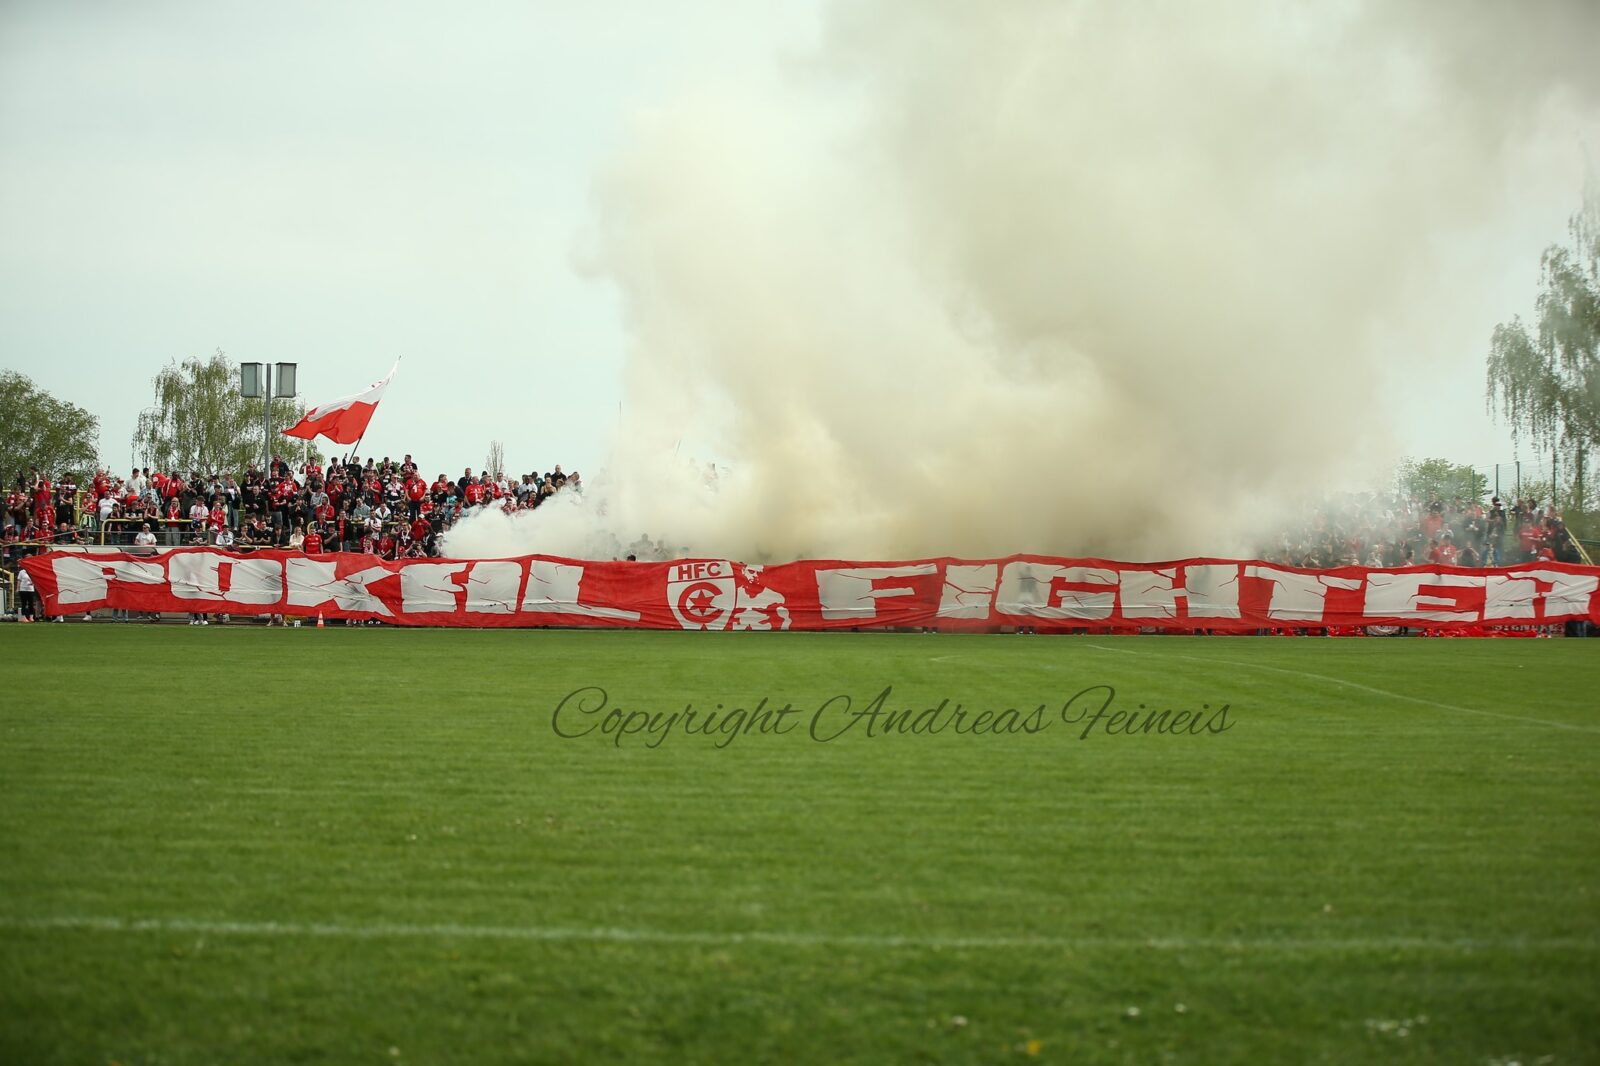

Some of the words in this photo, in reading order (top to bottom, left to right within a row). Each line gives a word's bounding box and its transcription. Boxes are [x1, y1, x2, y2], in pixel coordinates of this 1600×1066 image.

[52, 552, 641, 622] POKAL
[815, 561, 1600, 623] FIGHTER
[678, 562, 721, 580] HFC
